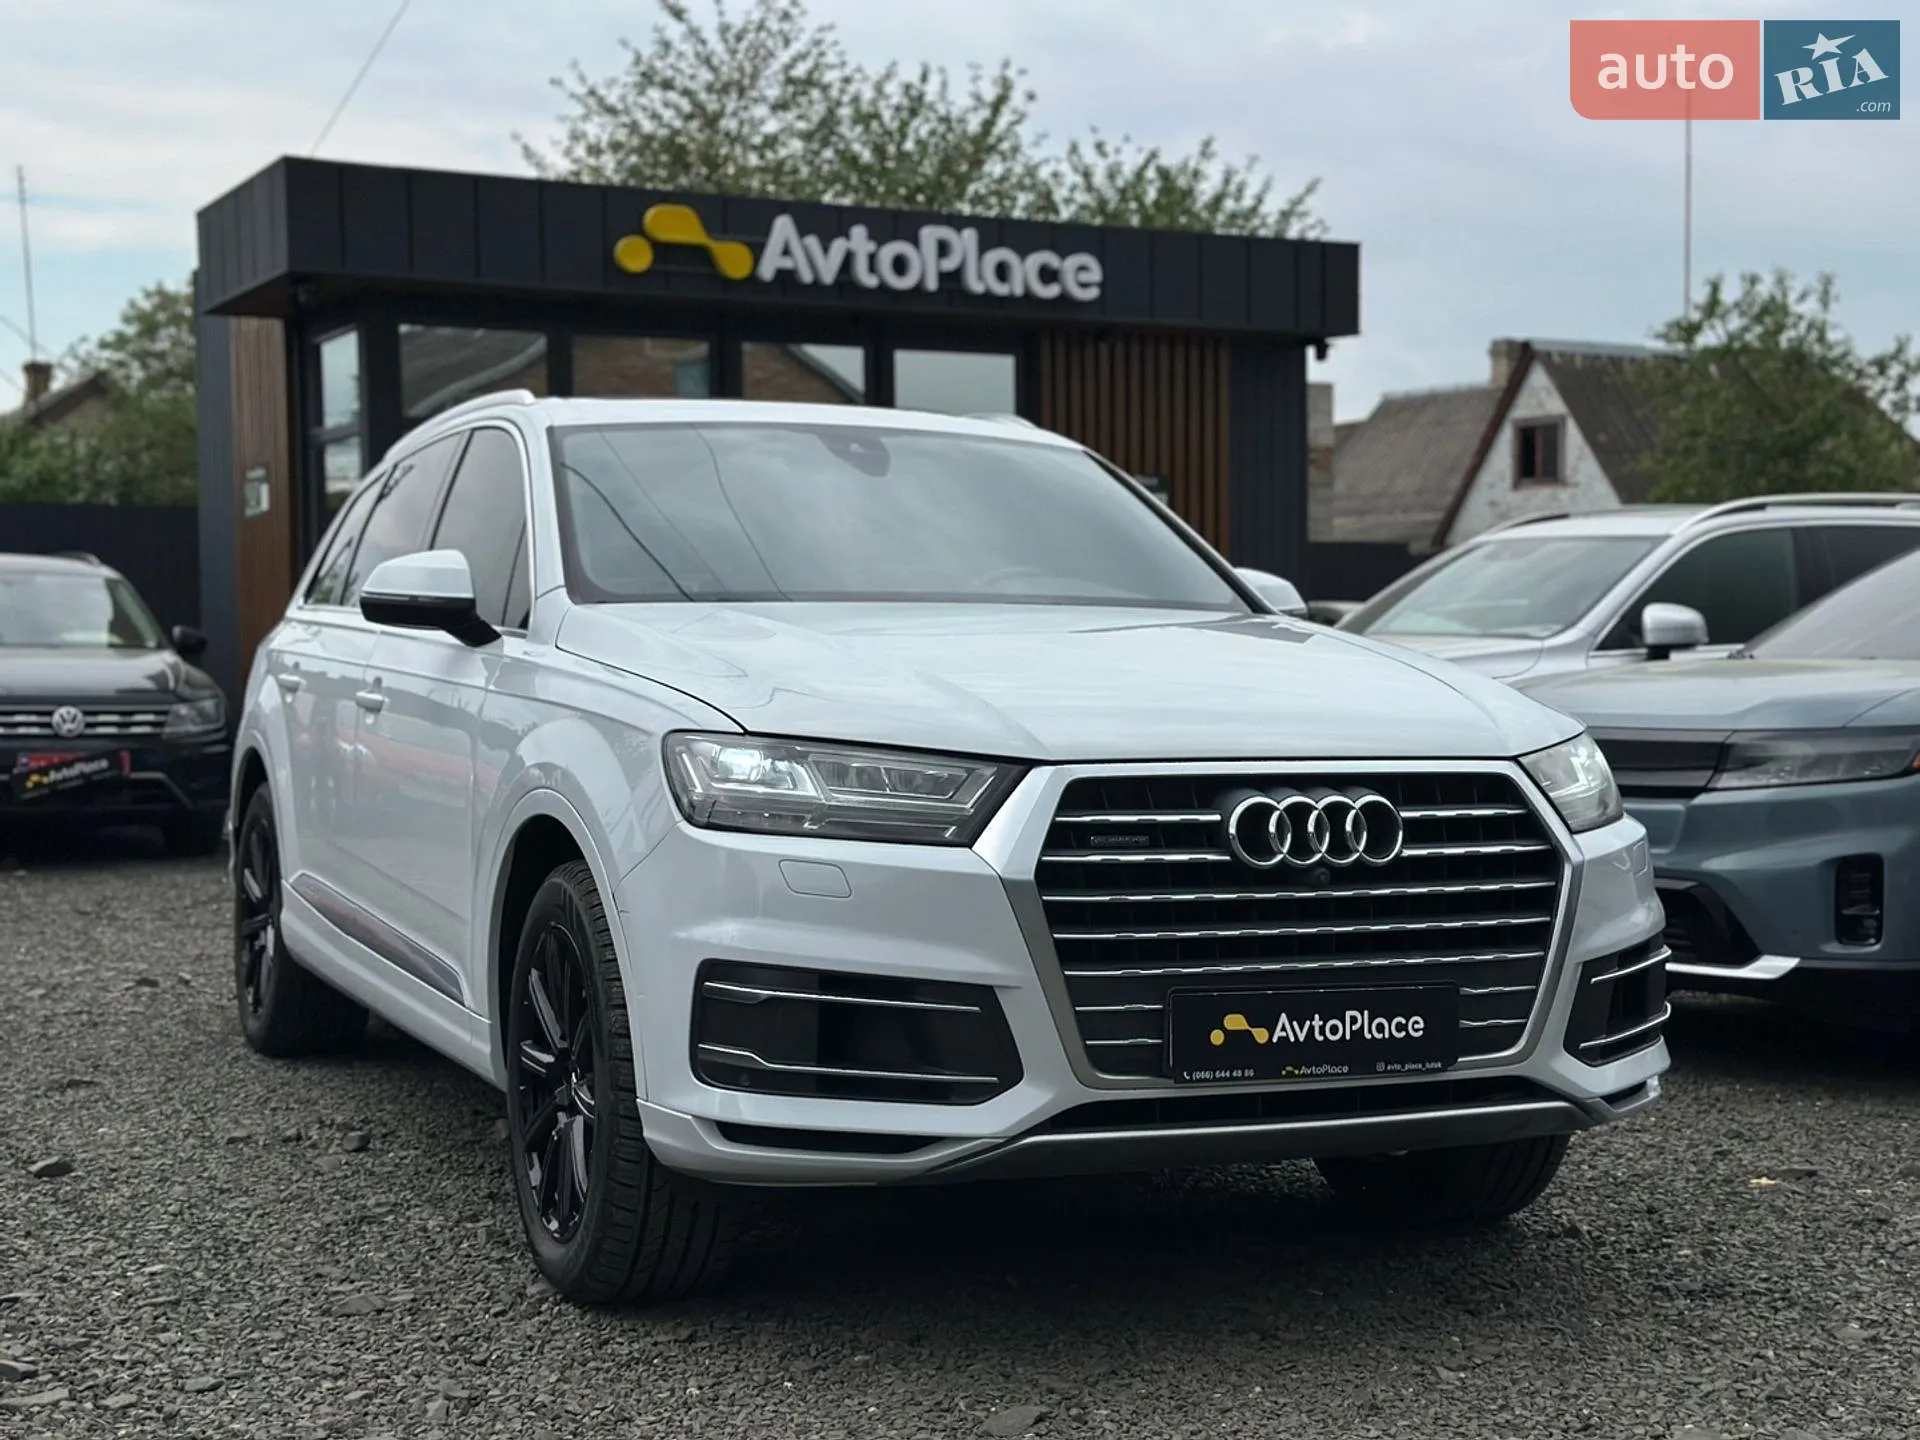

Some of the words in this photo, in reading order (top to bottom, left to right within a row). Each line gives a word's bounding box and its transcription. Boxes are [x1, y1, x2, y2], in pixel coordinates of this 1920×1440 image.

[756, 212, 1104, 302] AvtoPlace
[1271, 1009, 1426, 1044] AvtoPlace
[1299, 1063, 1349, 1076] AvtoPlace
